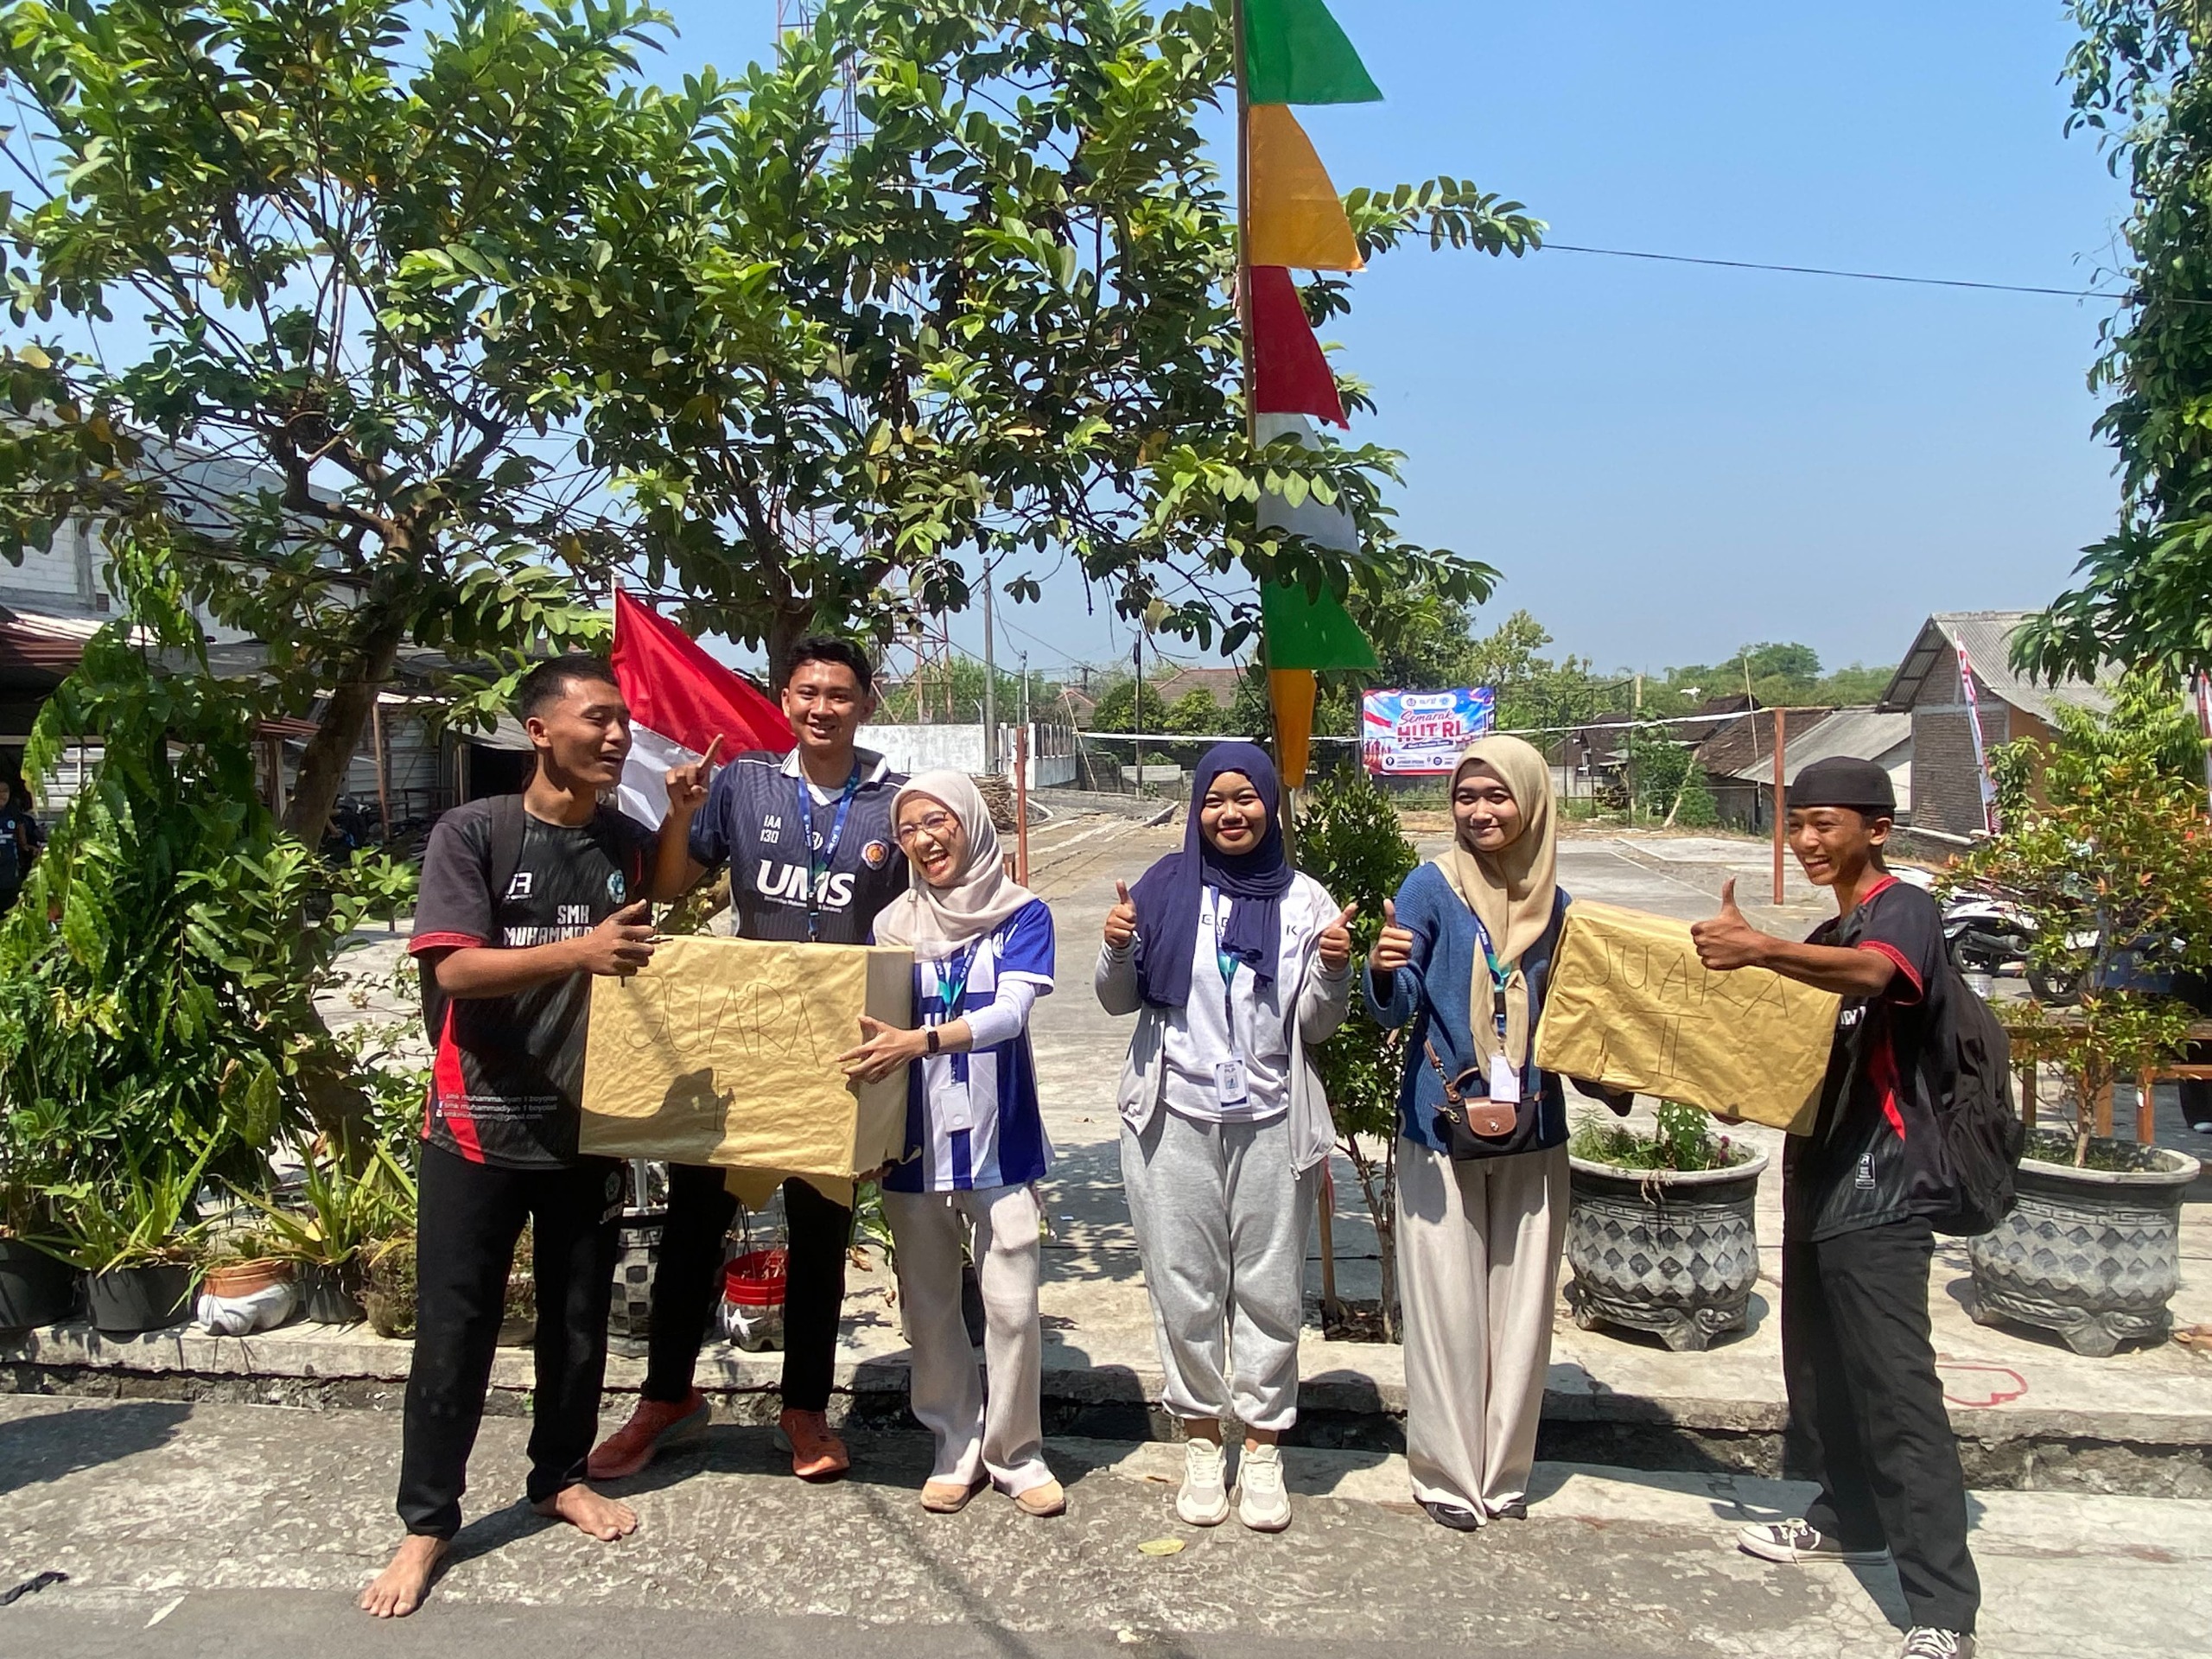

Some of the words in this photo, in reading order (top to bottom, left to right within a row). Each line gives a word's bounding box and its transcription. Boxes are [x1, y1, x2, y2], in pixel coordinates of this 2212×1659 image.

[1397, 722, 1438, 742] HUT
[1442, 720, 1461, 738] RI
[1399, 709, 1454, 726] Semarak
[760, 829, 780, 844] 130
[756, 859, 855, 907] UMS
[1583, 934, 1789, 1019] JUARA
[624, 975, 821, 1068] JUARA
